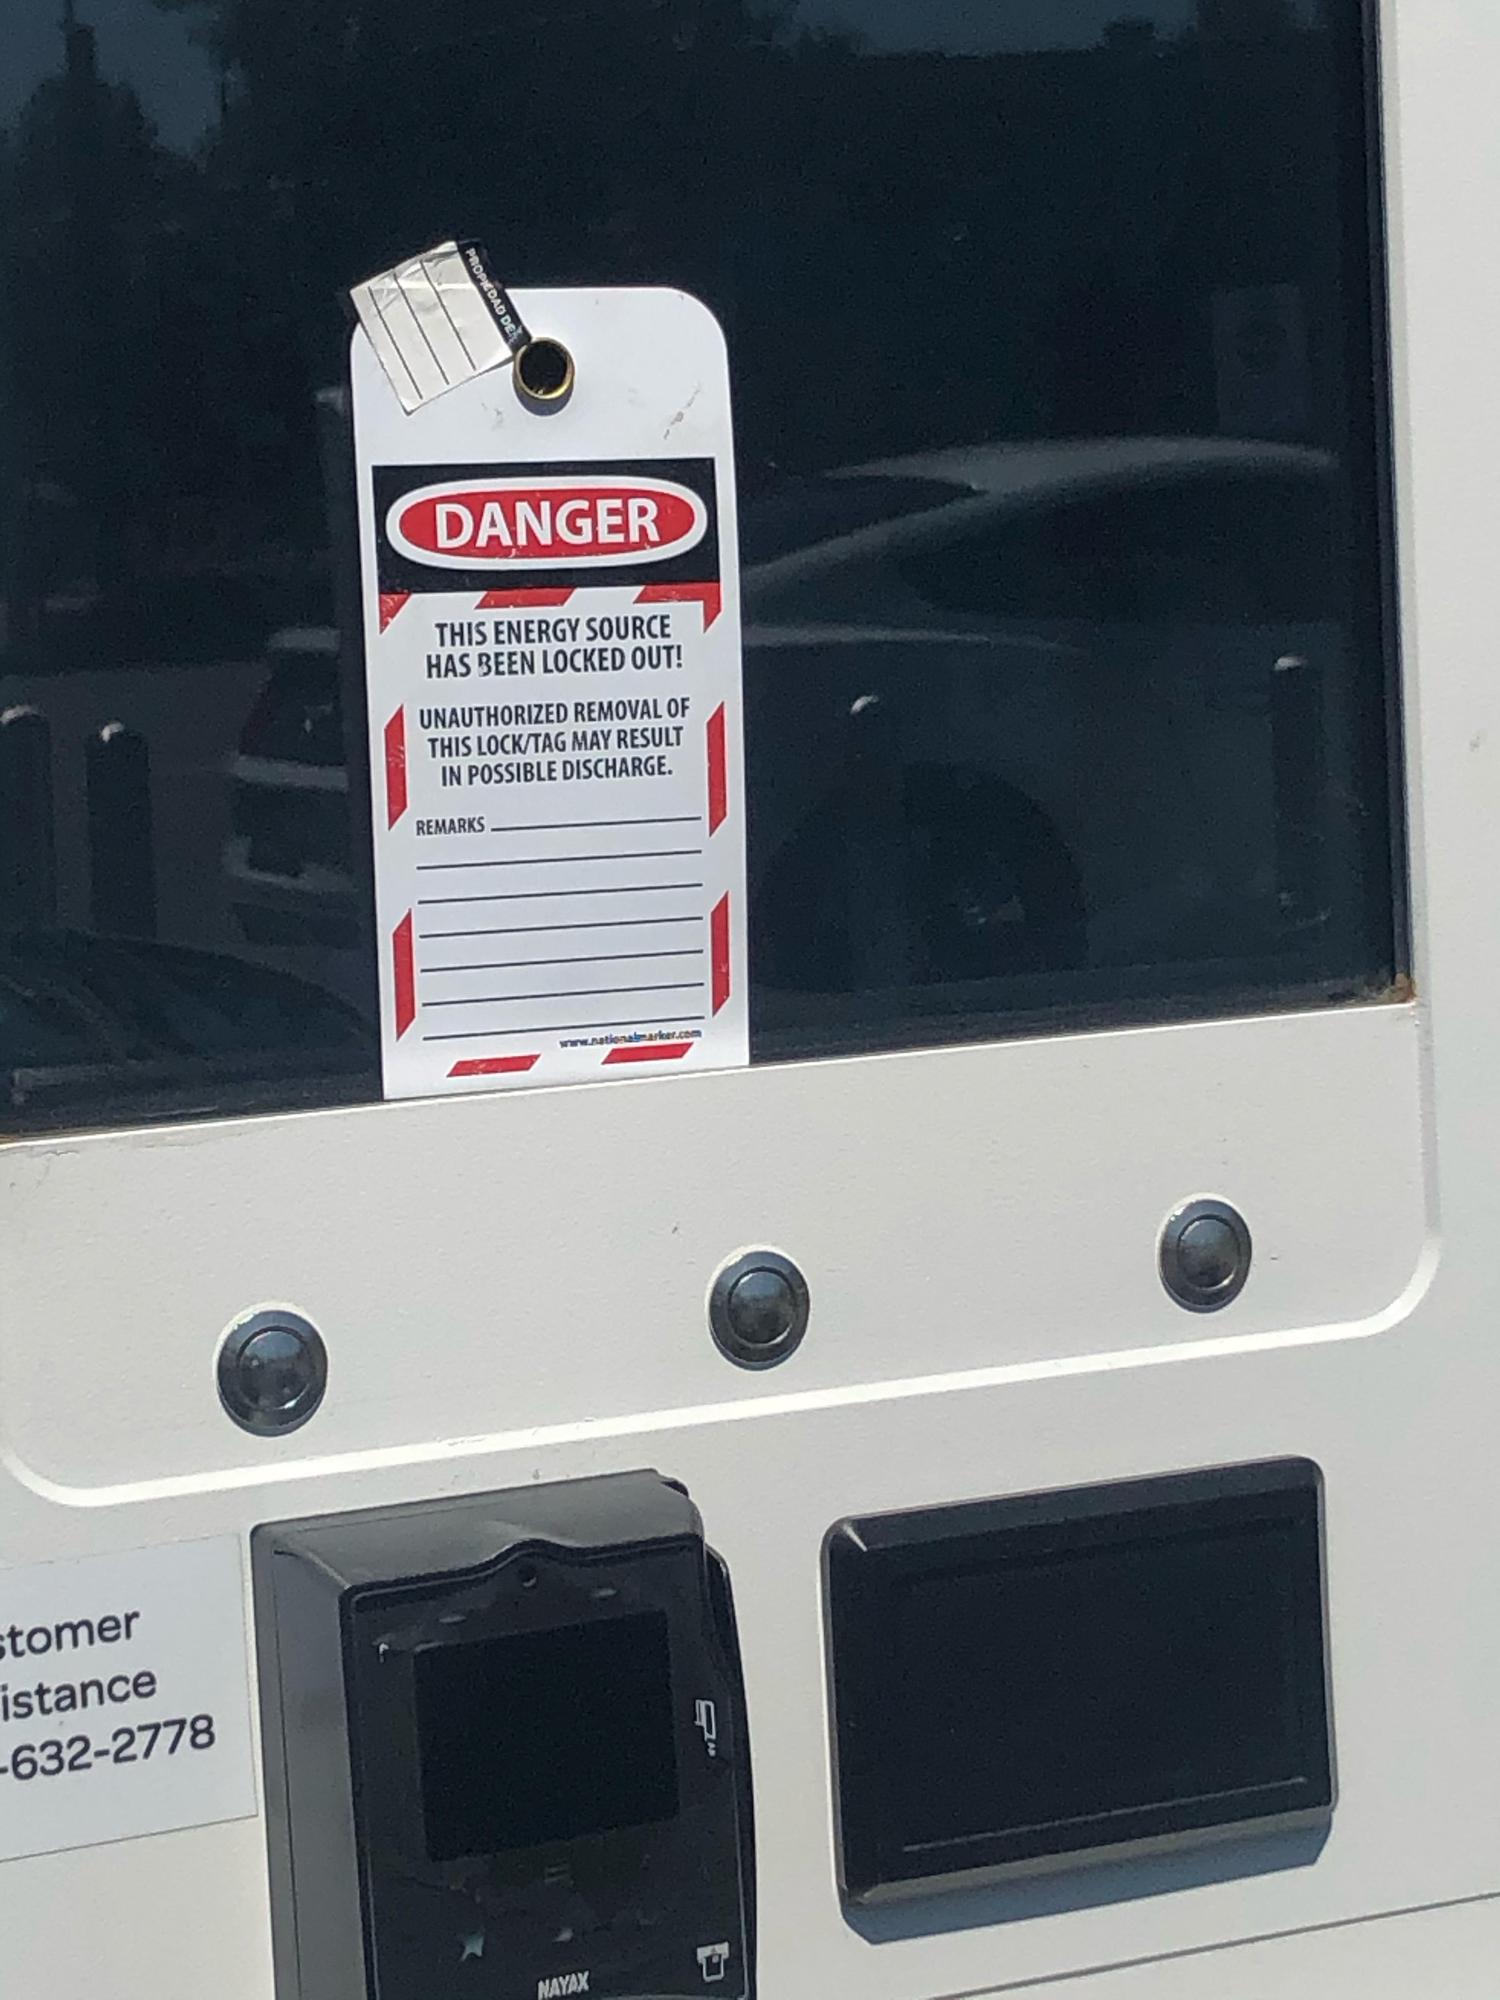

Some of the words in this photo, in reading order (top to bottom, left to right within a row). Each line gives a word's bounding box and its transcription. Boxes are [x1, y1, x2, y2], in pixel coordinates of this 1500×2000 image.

[434, 497, 660, 549] DANGER
[435, 621, 487, 647] THIS
[494, 617, 579, 644] ENERGY
[586, 614, 671, 640] SOURCE
[426, 652, 472, 679] HAS
[478, 649, 535, 676] BEEN
[542, 647, 625, 674] LOCKED
[631, 644, 683, 670] OUT!
[419, 704, 568, 729] UNAUTHORIZED
[574, 700, 662, 723] REMOVAL
[667, 697, 691, 719] OF
[428, 735, 472, 758] THIS
[477, 730, 567, 756] LOCK/TAG
[572, 729, 612, 751] MAY
[617, 726, 684, 748] RESULT
[441, 765, 462, 787] IN
[468, 761, 557, 785] POSSIBLE
[562, 755, 673, 781] DISCHARGE.
[416, 816, 485, 836] REMARKS
[559, 1030, 702, 1048] www.nationalmarker.com
[1, 1670, 156, 1722] istance
[538, 1970, 590, 2000] NAYAX
